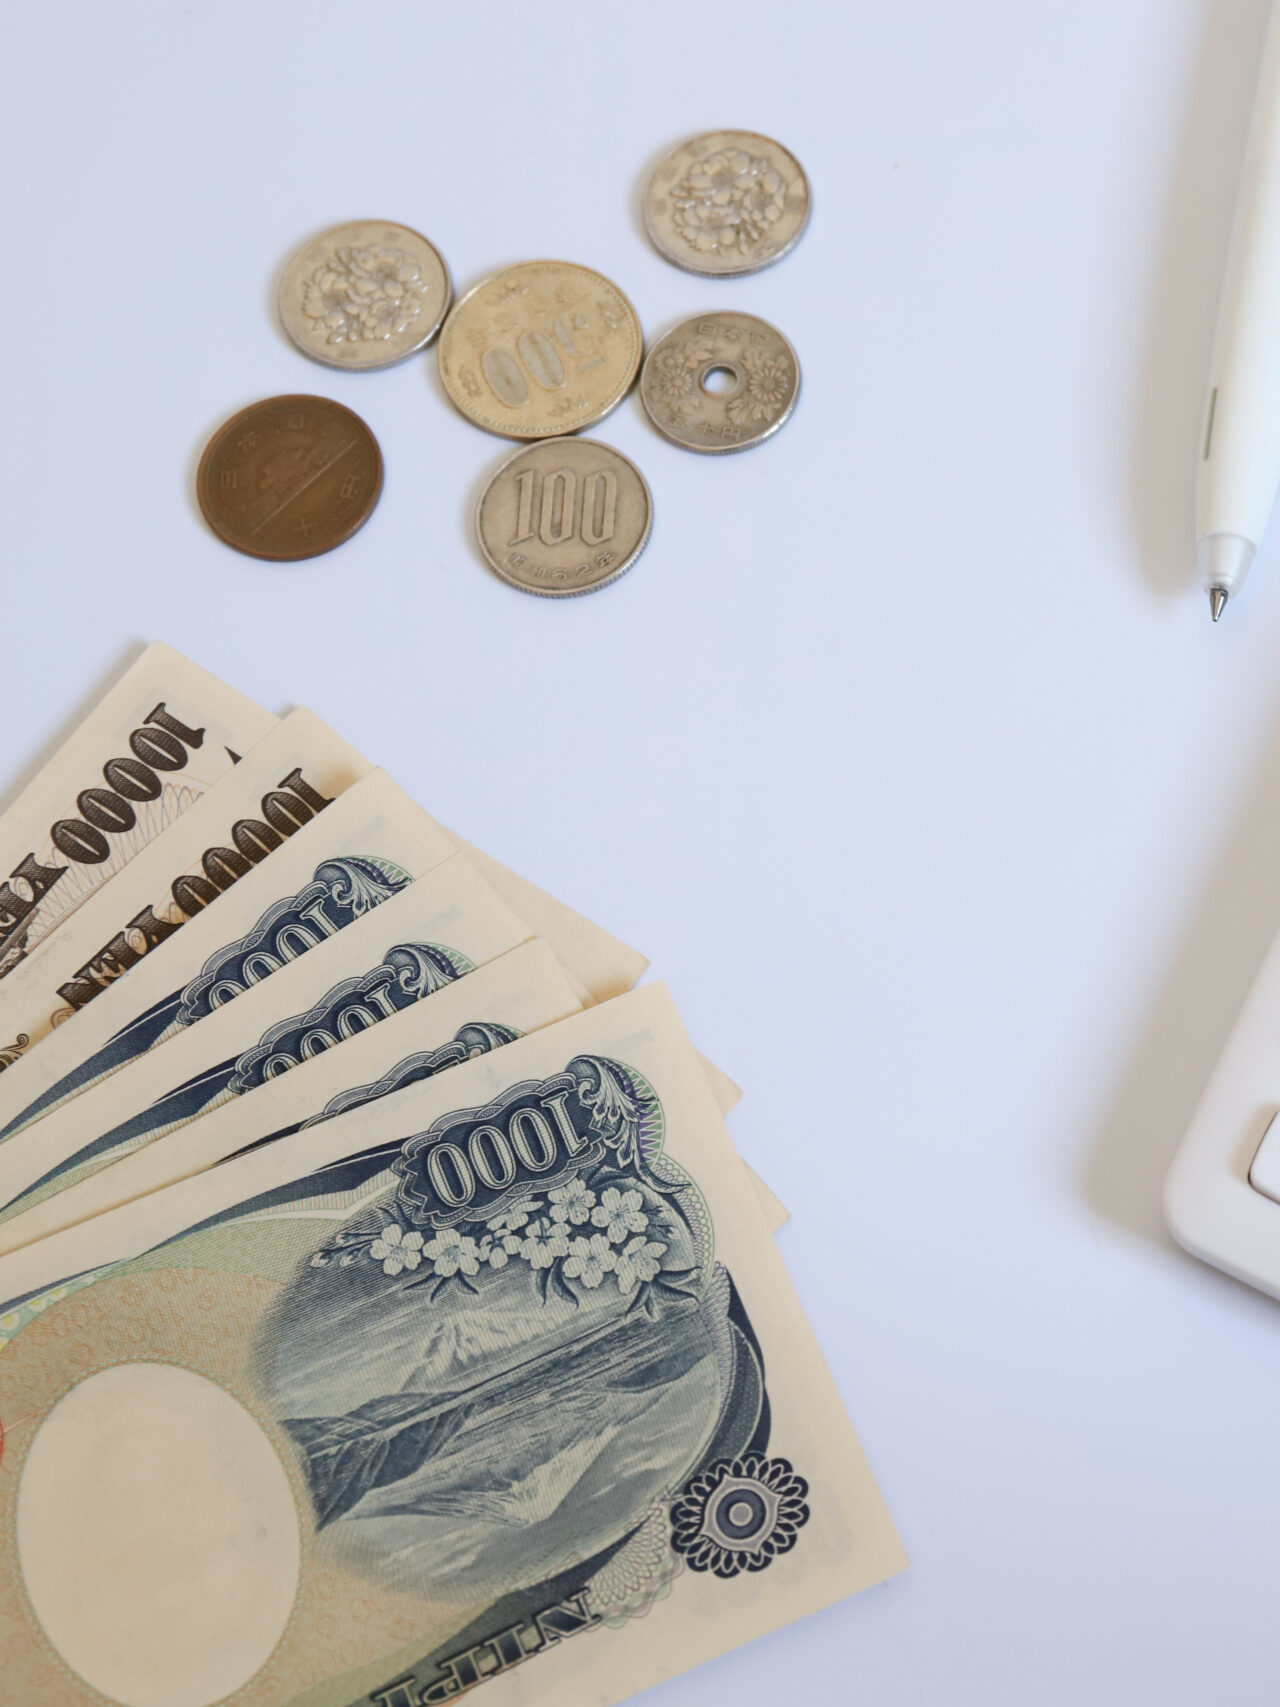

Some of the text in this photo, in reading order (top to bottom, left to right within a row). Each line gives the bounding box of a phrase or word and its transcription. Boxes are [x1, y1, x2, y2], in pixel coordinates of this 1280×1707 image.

[507, 467, 618, 547] 100
[51, 702, 206, 865] 10000
[427, 1091, 588, 1208] 1000
